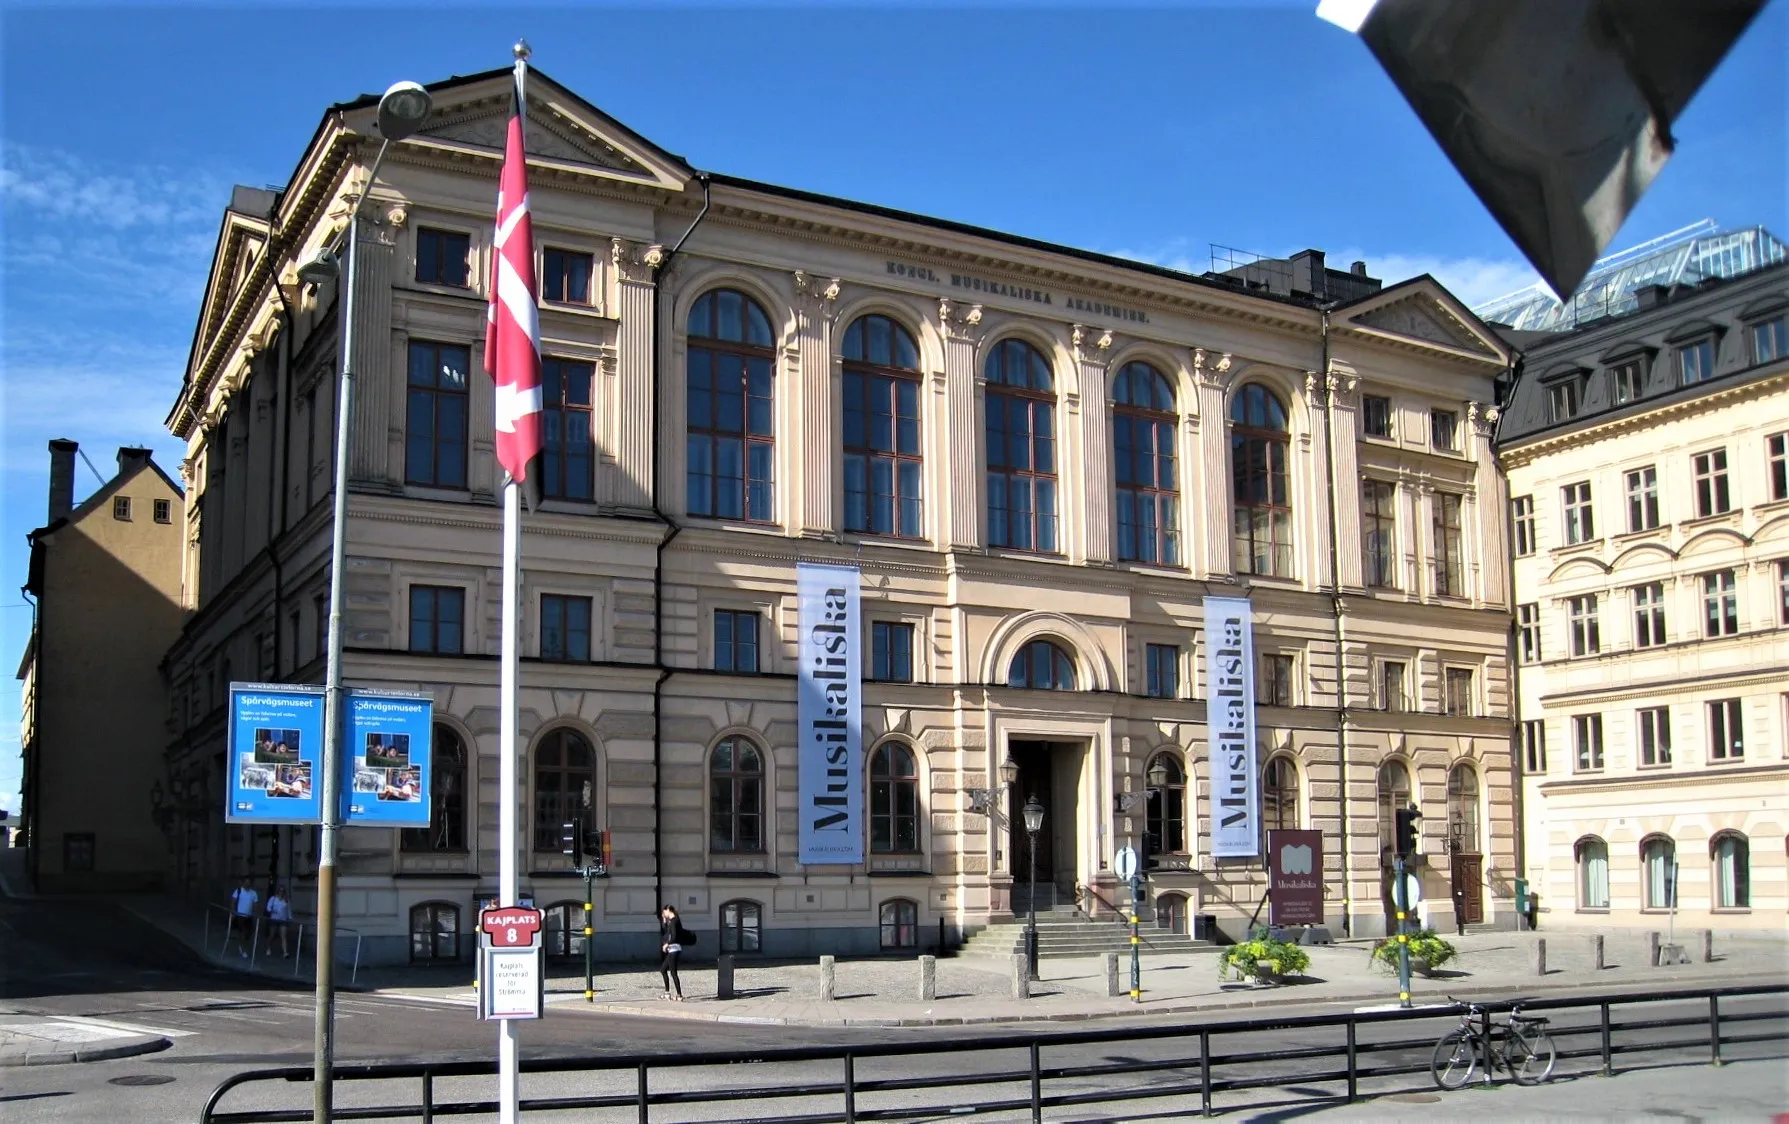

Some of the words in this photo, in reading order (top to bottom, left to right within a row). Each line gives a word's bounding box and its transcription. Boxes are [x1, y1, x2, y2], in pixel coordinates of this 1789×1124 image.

[886, 260, 941, 283] KONGL.
[951, 274, 1052, 305] MUSIKALISKA
[241, 696, 313, 708] Spårvägsmuseet
[353, 701, 423, 713] Spårvägsmuseet
[812, 588, 849, 834] Musikaliska
[1216, 618, 1248, 830] Musikaliska
[1277, 879, 1317, 889] Musikaliska
[486, 916, 536, 927] KAJPLATS
[507, 928, 518, 943] 8
